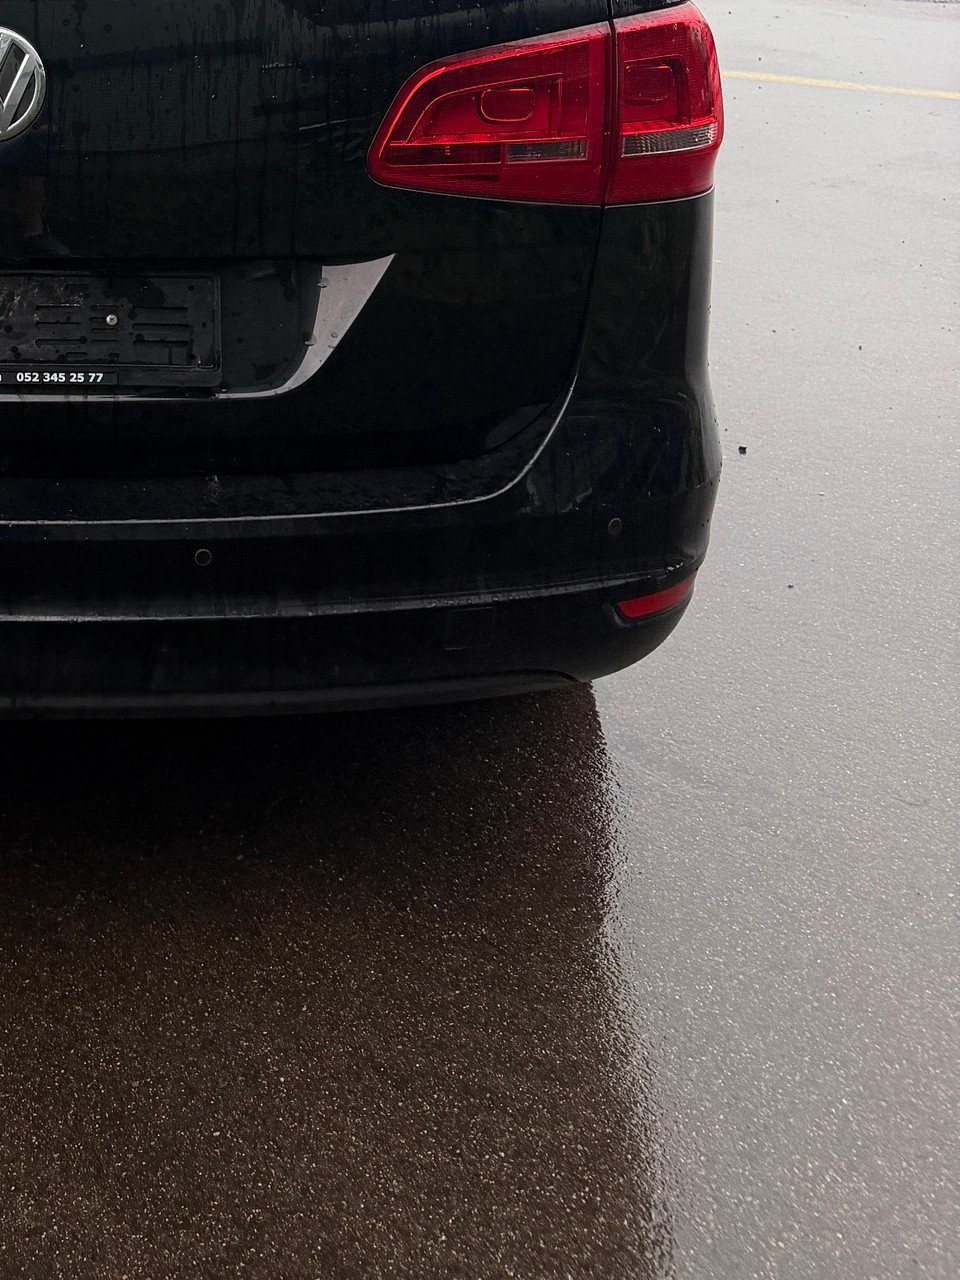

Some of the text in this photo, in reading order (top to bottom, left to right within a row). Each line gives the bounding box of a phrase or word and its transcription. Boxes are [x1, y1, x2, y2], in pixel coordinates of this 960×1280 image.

[16, 372, 40, 382] 052
[43, 372, 66, 383] 345
[69, 372, 85, 383] 25
[88, 373, 104, 383] 77
